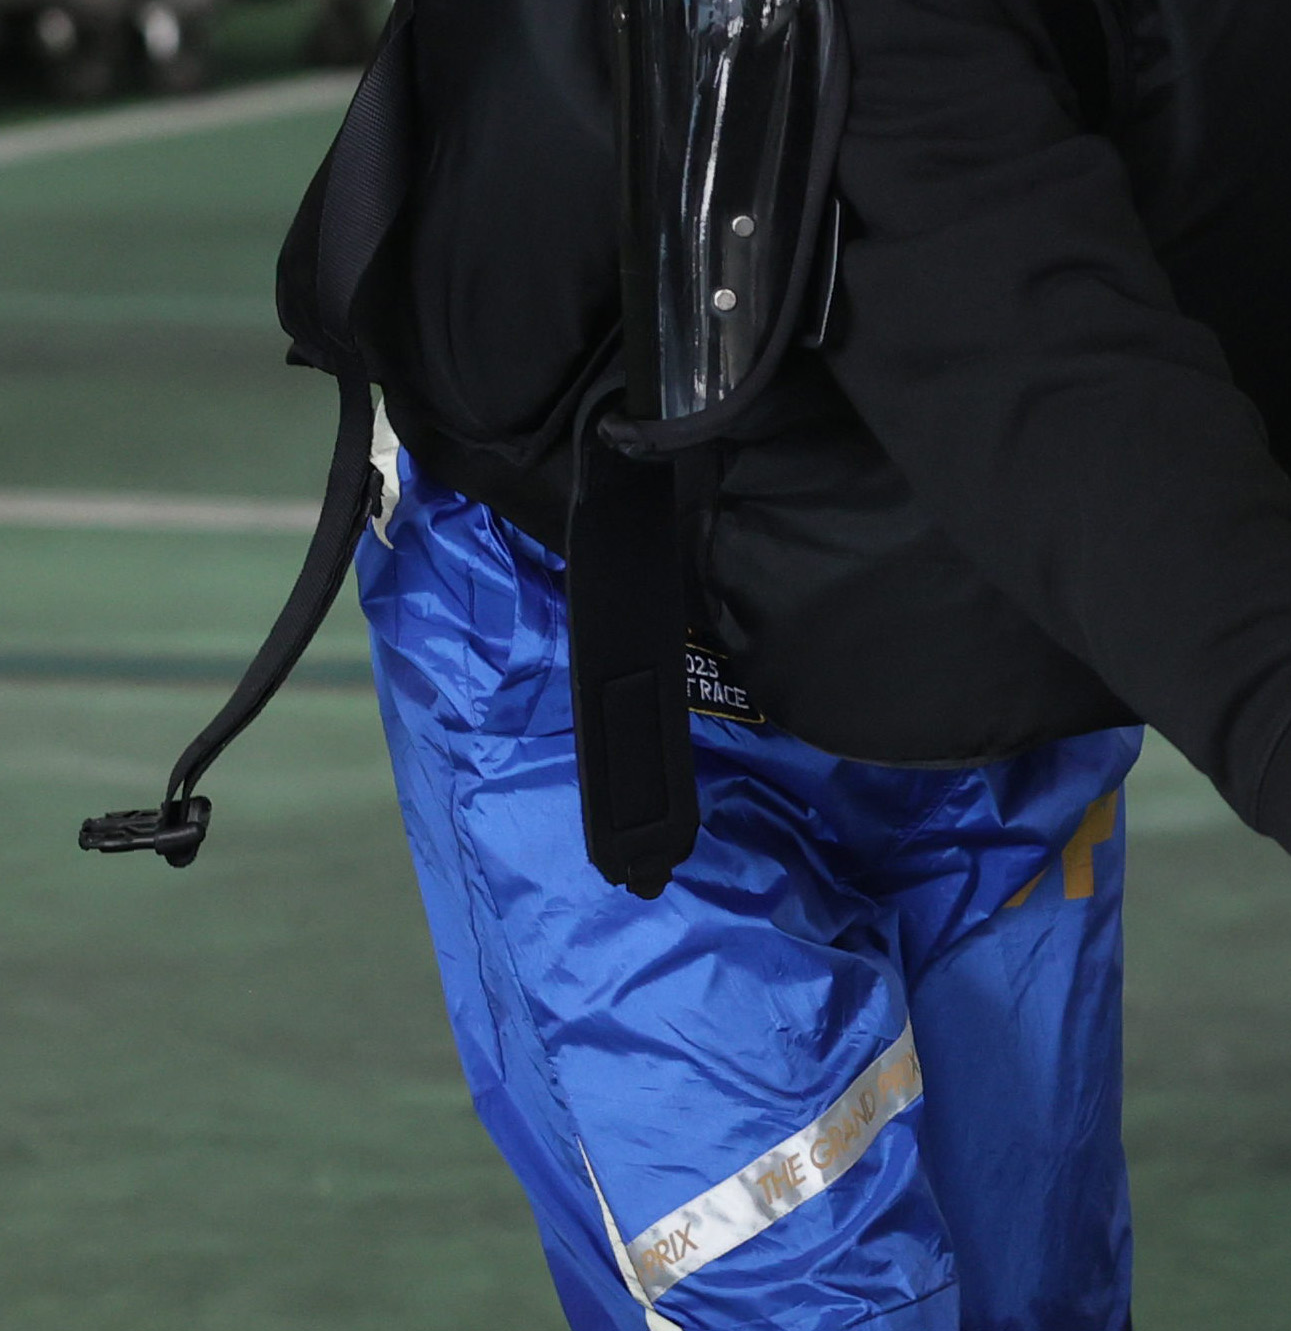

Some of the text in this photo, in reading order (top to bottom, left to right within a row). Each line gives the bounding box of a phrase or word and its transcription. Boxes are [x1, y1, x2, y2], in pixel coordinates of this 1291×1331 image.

[699, 679, 750, 709] RACE
[756, 1153, 807, 1206] THE
[809, 1090, 876, 1170] GRAND
[641, 1222, 699, 1281] PRIX
